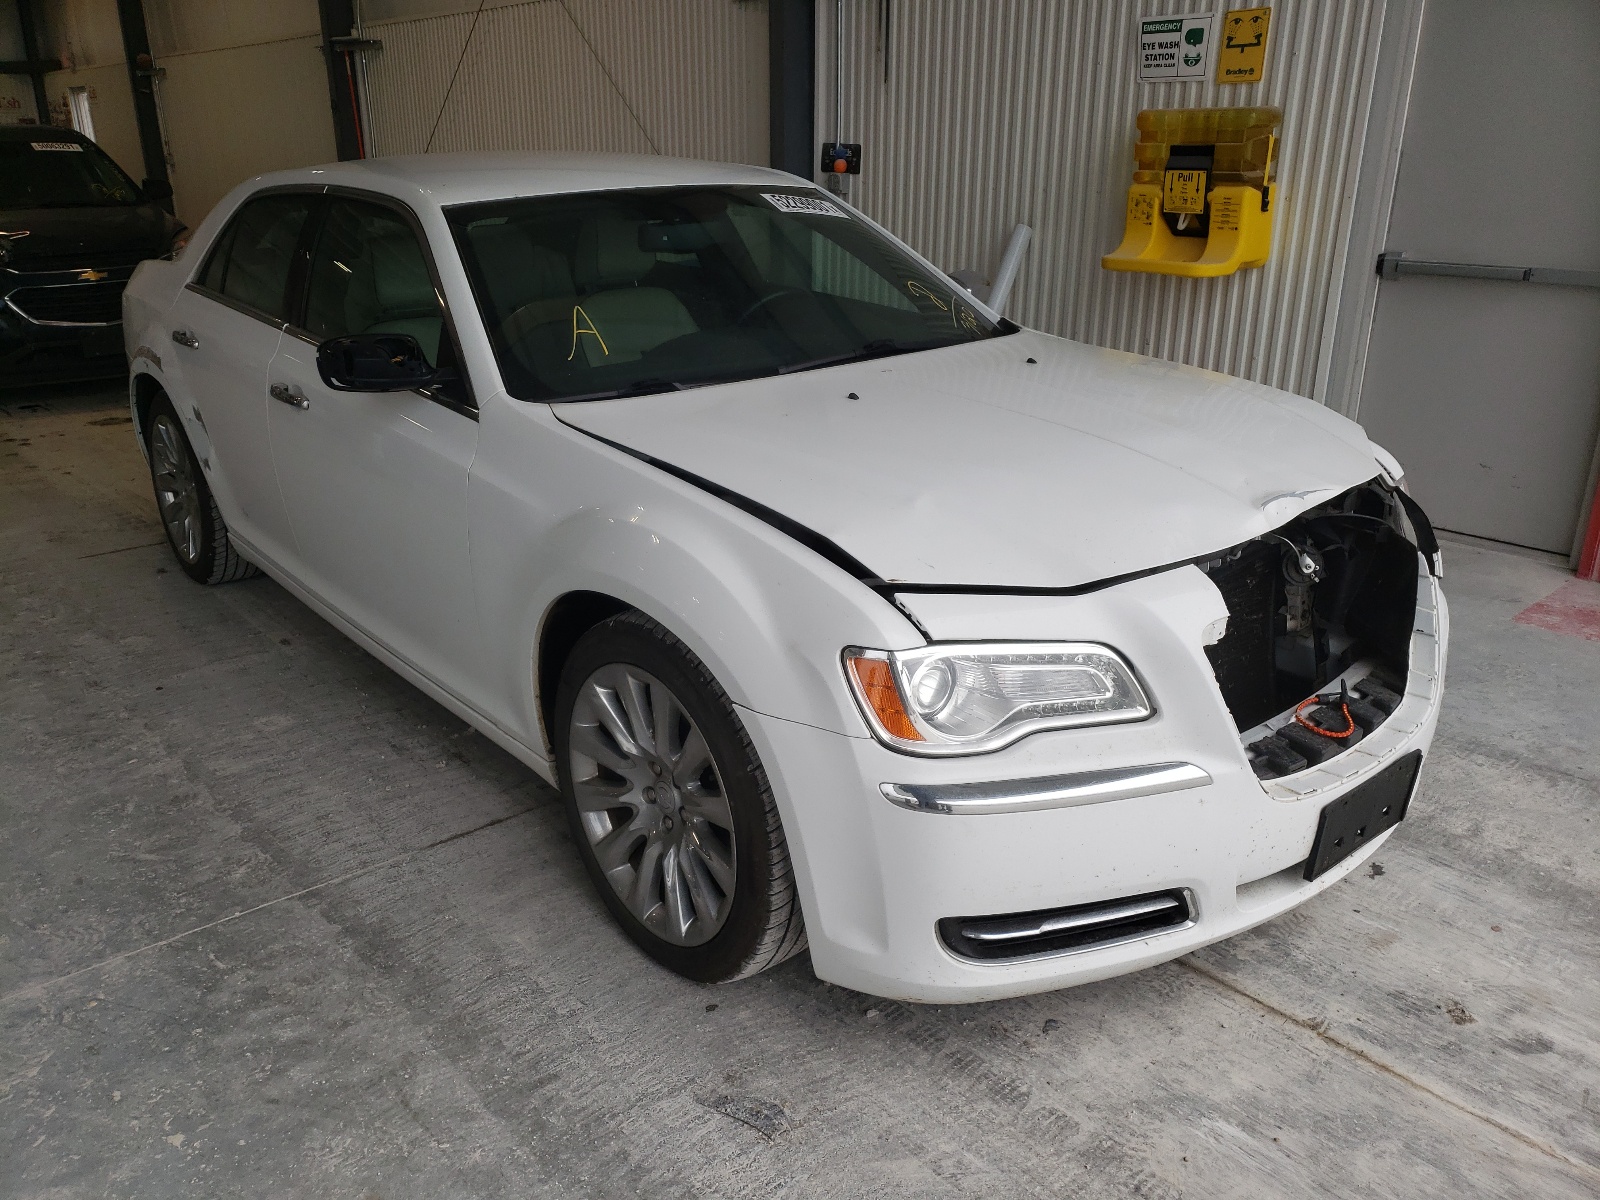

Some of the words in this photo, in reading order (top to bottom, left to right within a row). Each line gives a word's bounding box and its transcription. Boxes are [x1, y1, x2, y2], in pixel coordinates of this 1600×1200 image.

[1143, 22, 1181, 31] EMERGENCY
[1142, 42, 1156, 51] EYE
[1157, 40, 1180, 50] WASH
[1144, 53, 1175, 61] STATION
[1178, 172, 1193, 182] Pull
[567, 305, 609, 361] A
